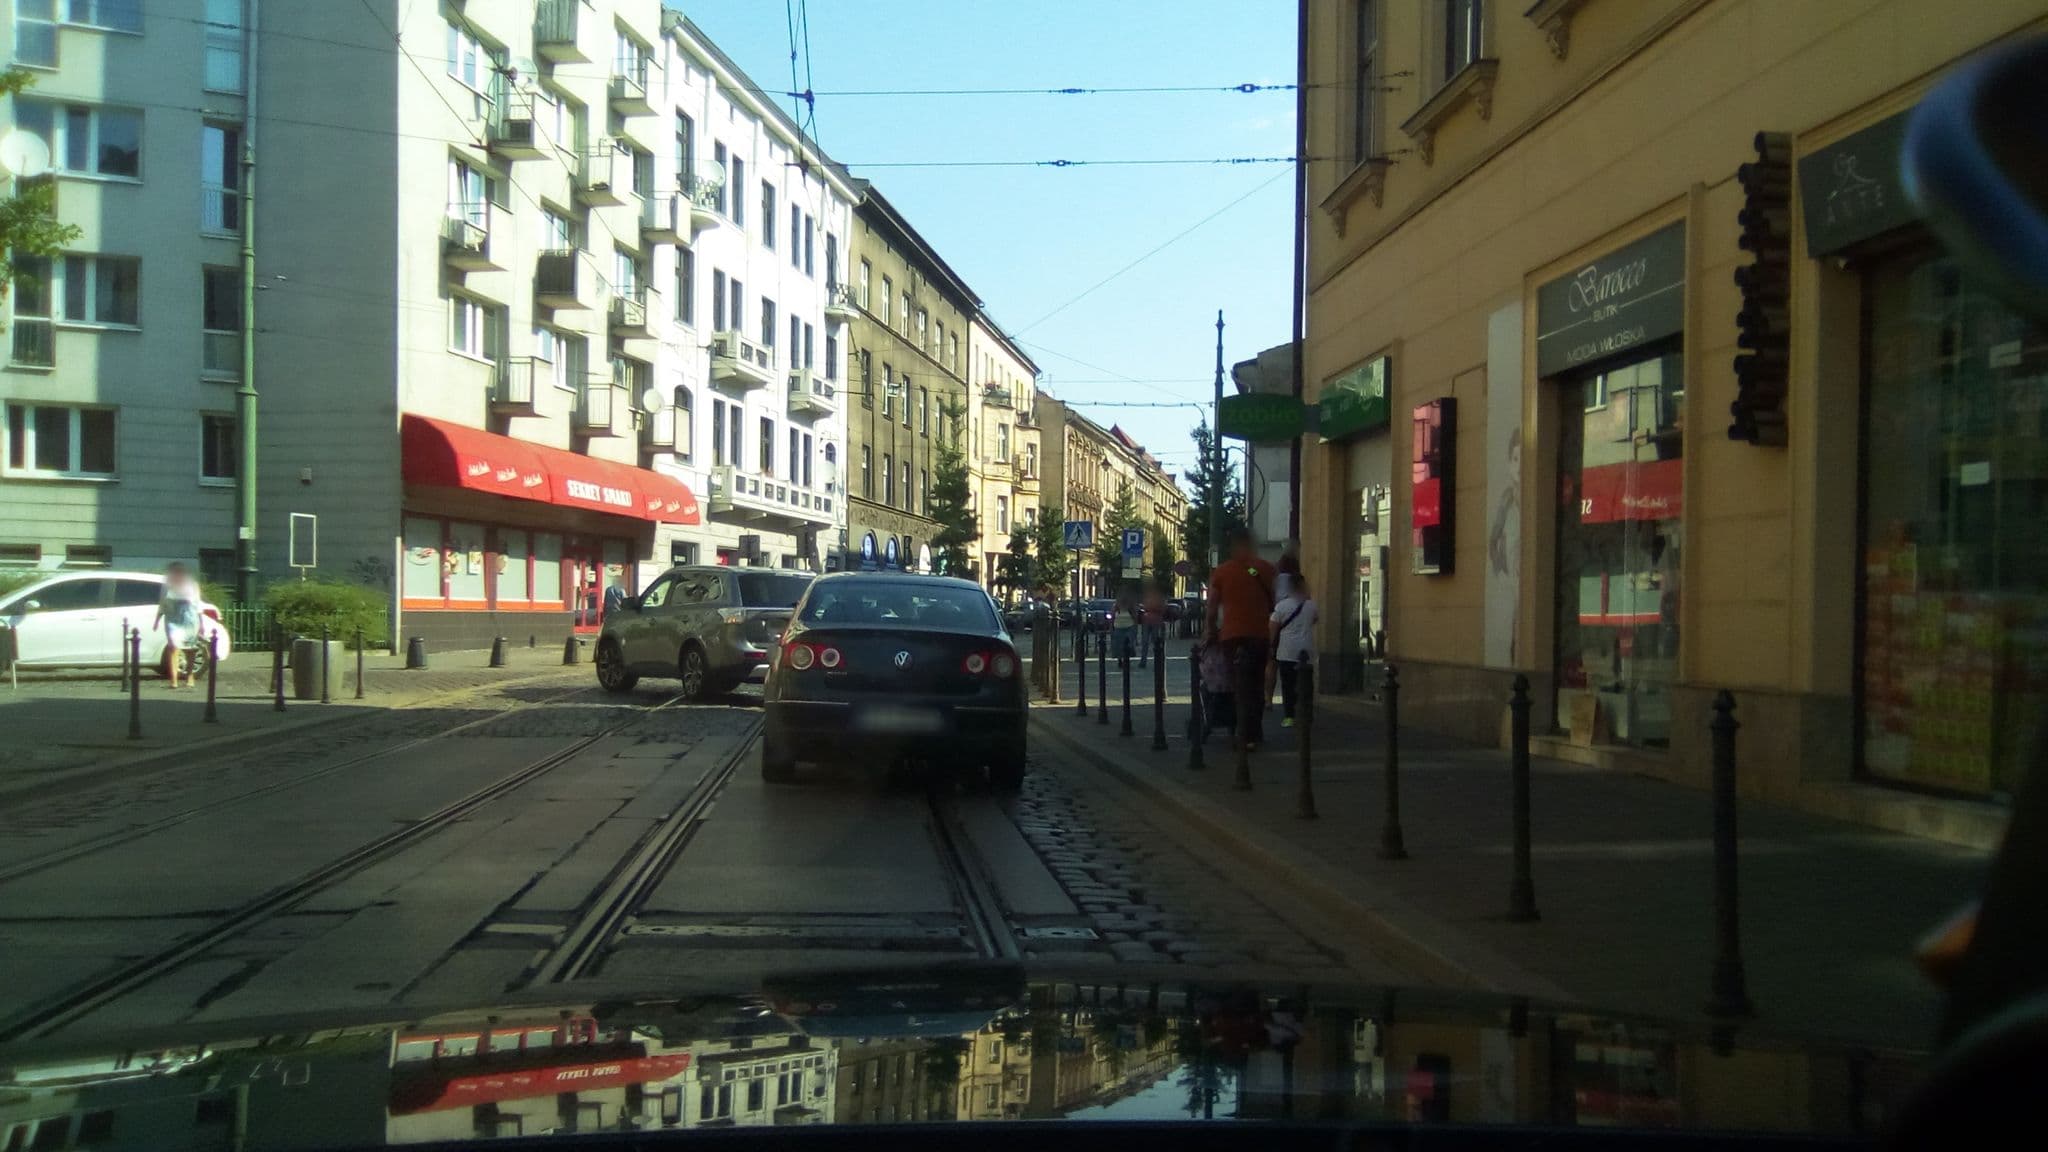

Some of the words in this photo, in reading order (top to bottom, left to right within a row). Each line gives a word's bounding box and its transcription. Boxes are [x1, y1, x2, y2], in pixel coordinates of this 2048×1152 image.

[1569, 258, 1647, 312] Barocco
[1593, 304, 1618, 322] BUTIK
[1567, 342, 1597, 362] MODA
[567, 479, 601, 502] SEKRET
[1127, 532, 1139, 549] P
